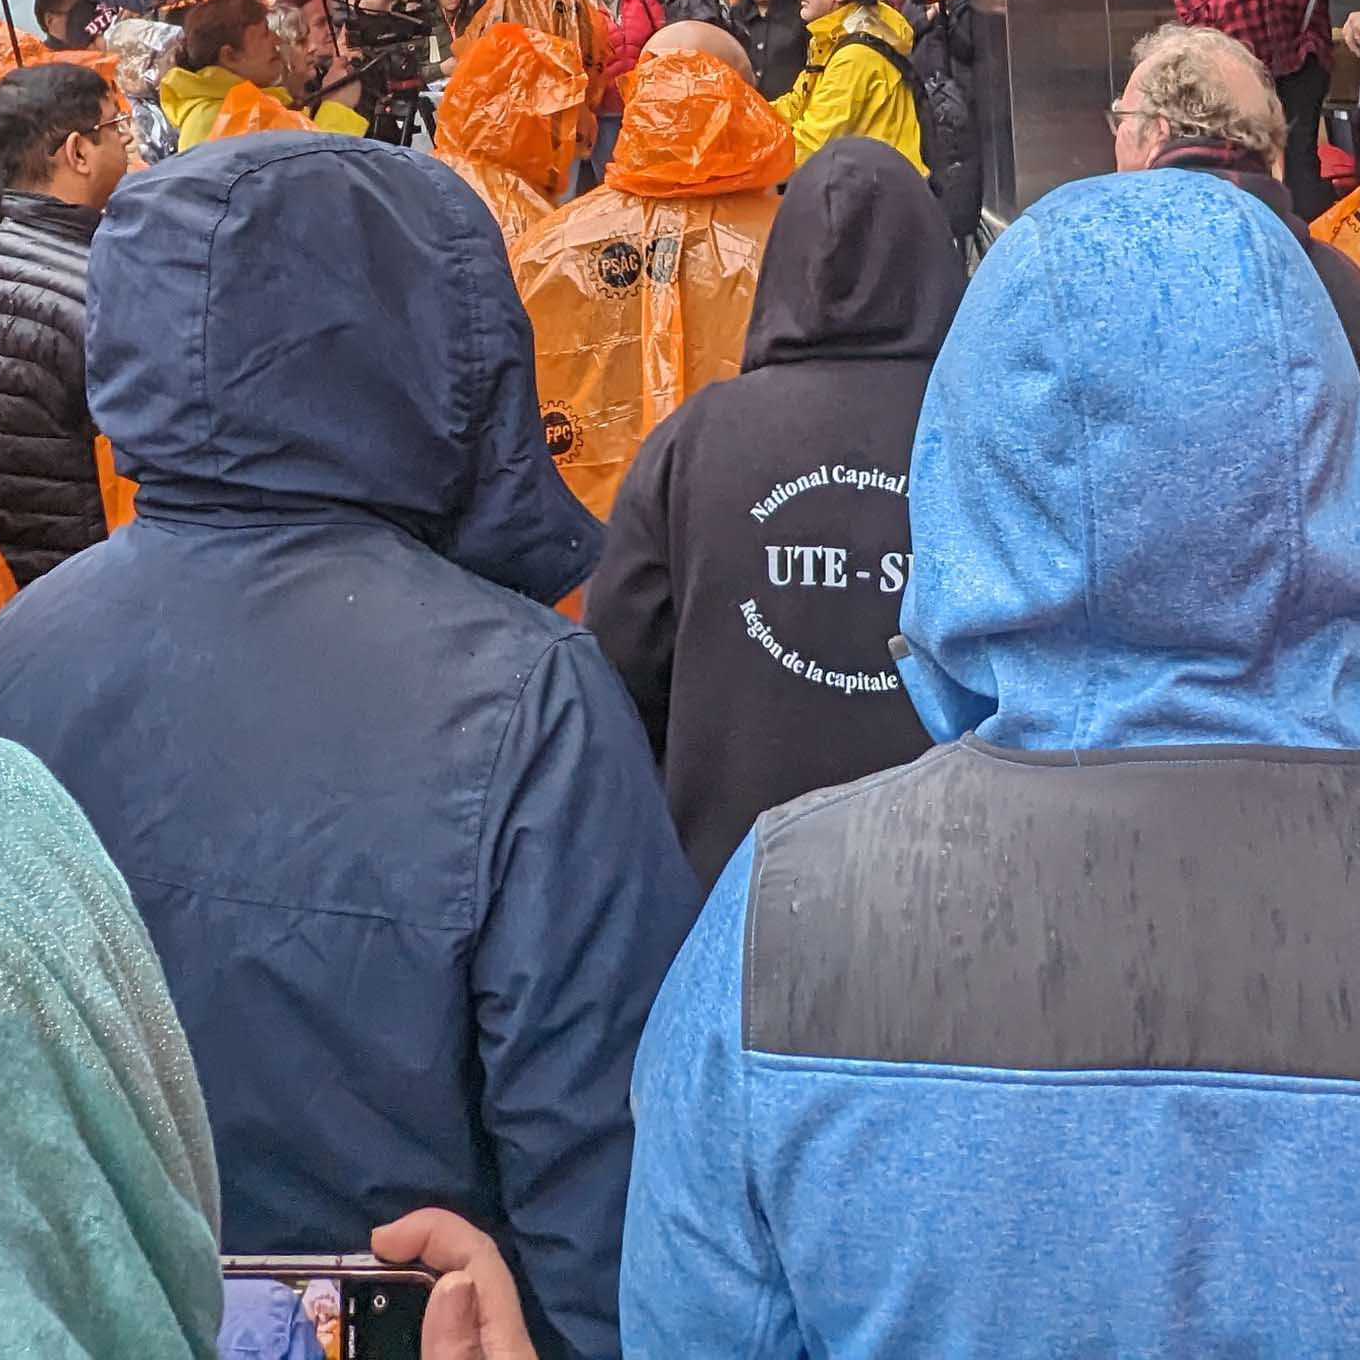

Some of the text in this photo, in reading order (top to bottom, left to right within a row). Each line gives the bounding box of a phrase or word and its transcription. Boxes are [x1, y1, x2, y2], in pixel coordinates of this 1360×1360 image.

[601, 255, 639, 277] PSAC
[750, 465, 907, 523] National Capital
[765, 545, 848, 588] UTE
[740, 598, 899, 694] Région de la capitale
